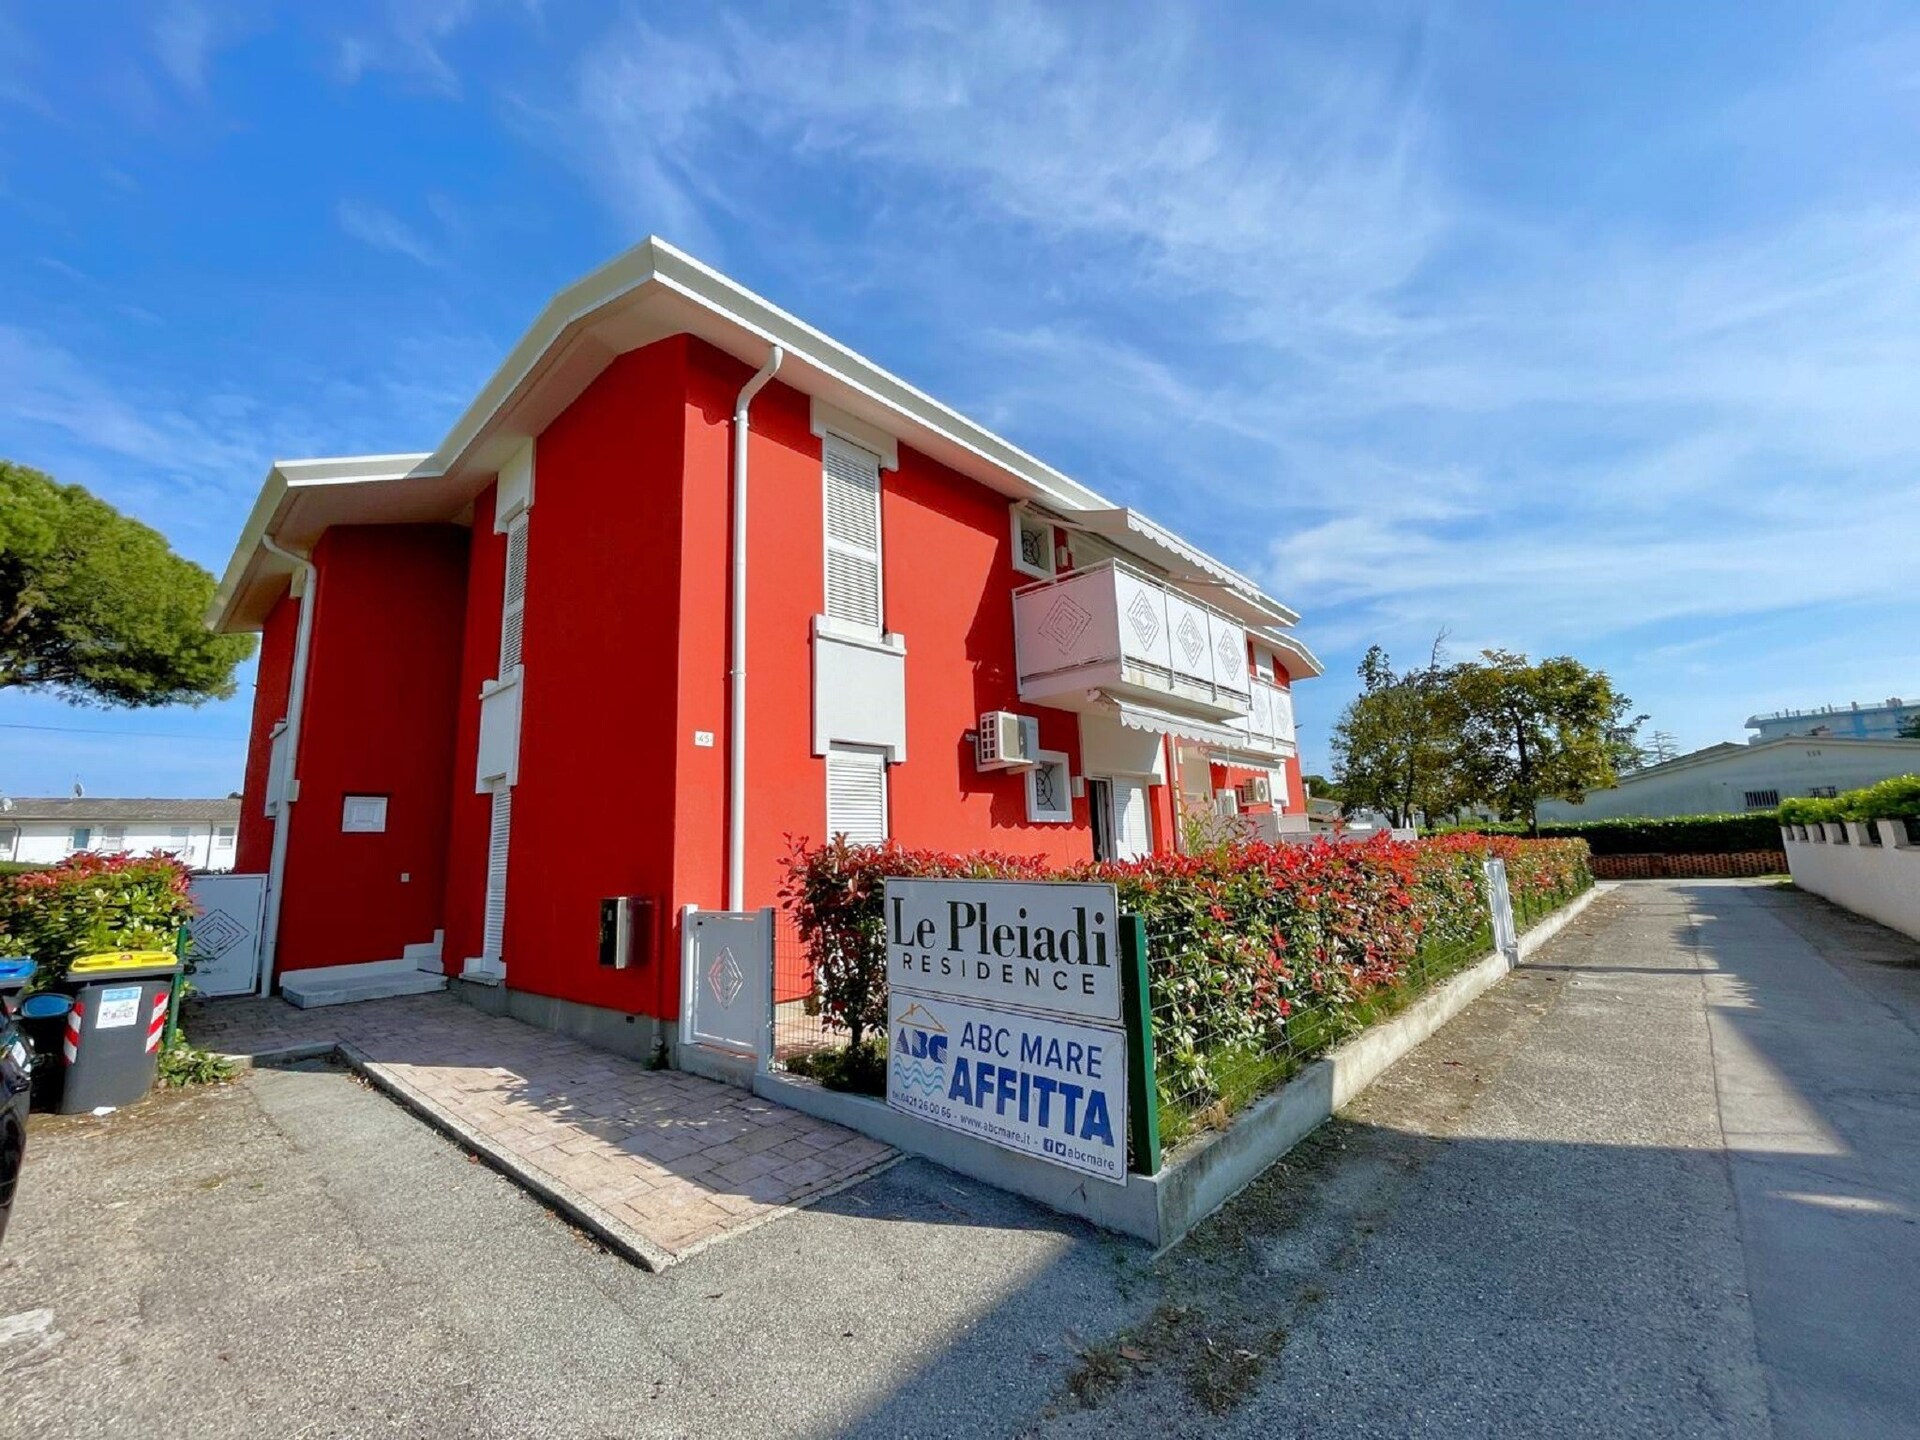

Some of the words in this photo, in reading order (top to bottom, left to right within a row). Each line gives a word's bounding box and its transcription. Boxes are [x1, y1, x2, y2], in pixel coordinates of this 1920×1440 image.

[891, 896, 936, 950] Le
[946, 900, 1111, 968] Pleiadi
[902, 952, 1096, 994] RESIDENCE
[894, 1027, 948, 1064] ABC
[960, 1021, 1011, 1058] ABC
[1020, 1032, 1103, 1079] MARE
[918, 1098, 928, 1111] 26
[930, 1102, 940, 1115] 00
[960, 1114, 1031, 1145] www.abcmare.it
[1067, 1147, 1115, 1170] abcmare
[948, 1056, 1115, 1148] AFFITTA
